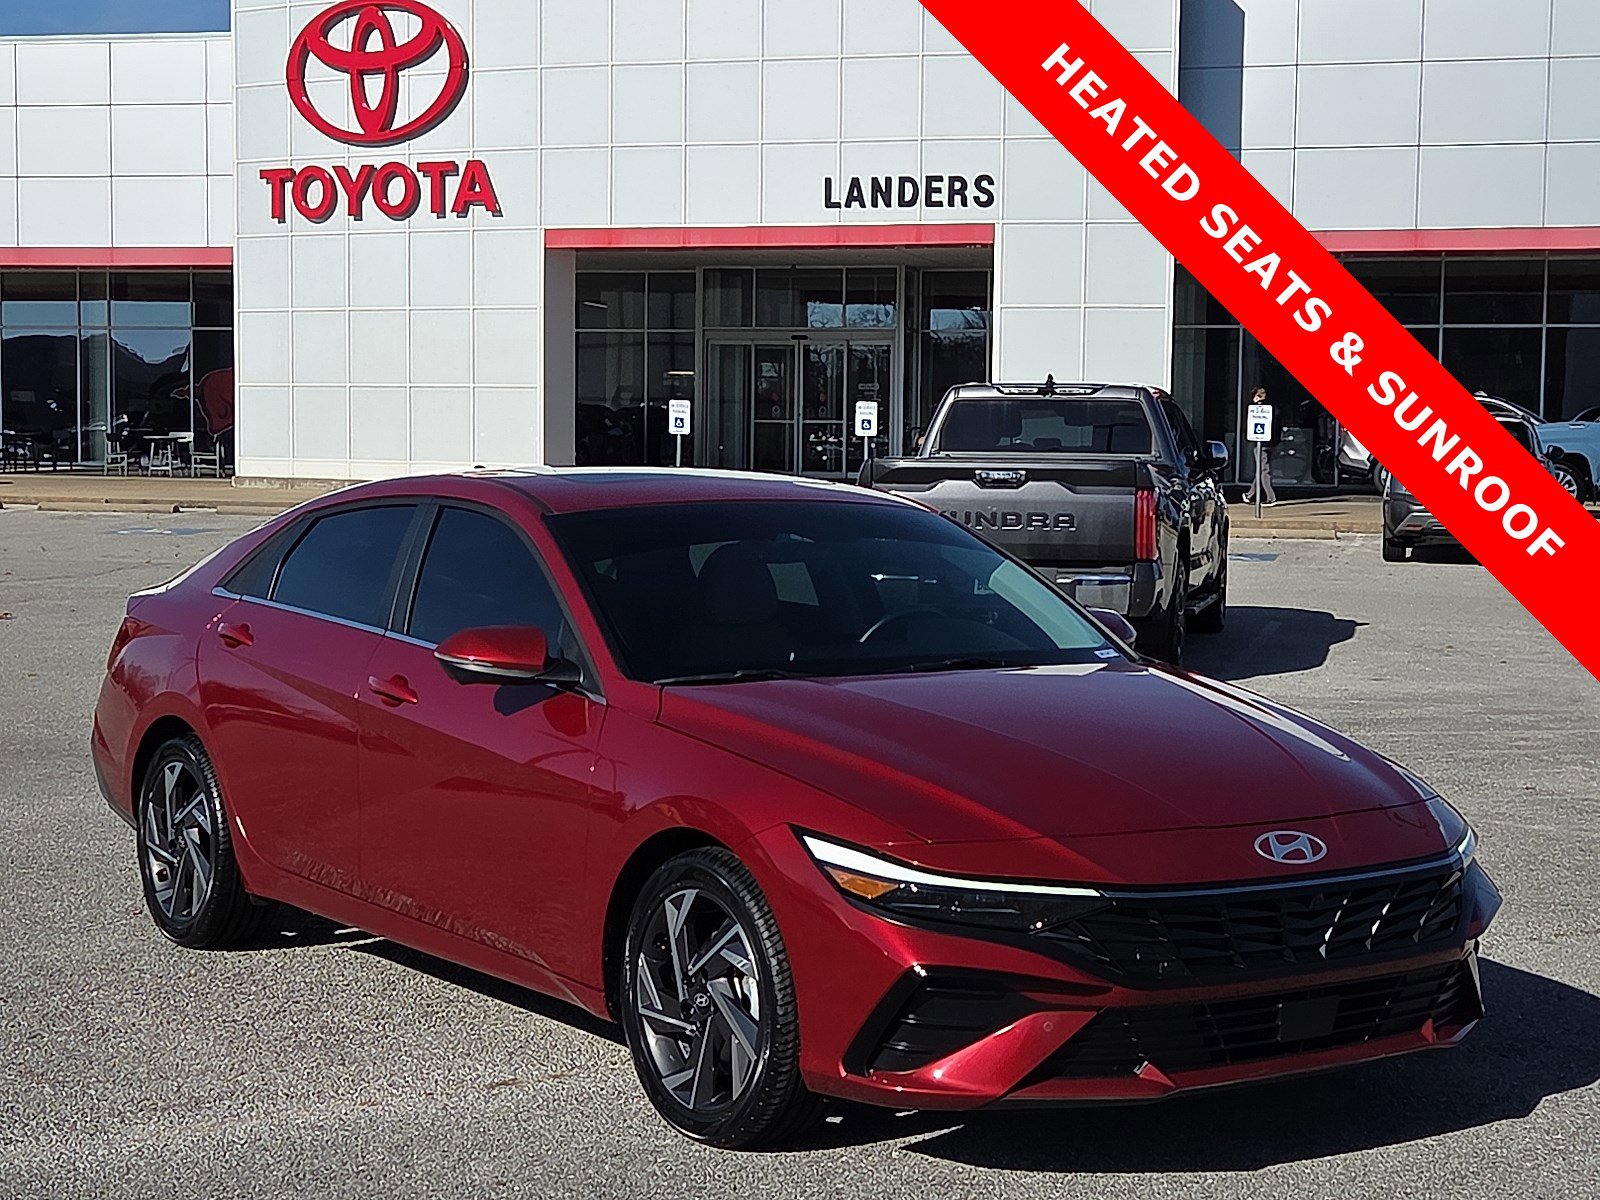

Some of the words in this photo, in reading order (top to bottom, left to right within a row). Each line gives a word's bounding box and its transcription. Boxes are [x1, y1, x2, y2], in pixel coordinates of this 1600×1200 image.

[259, 160, 503, 224] TOYOTA
[824, 174, 995, 209] LANDERS
[940, 510, 1077, 531] UNDRA
